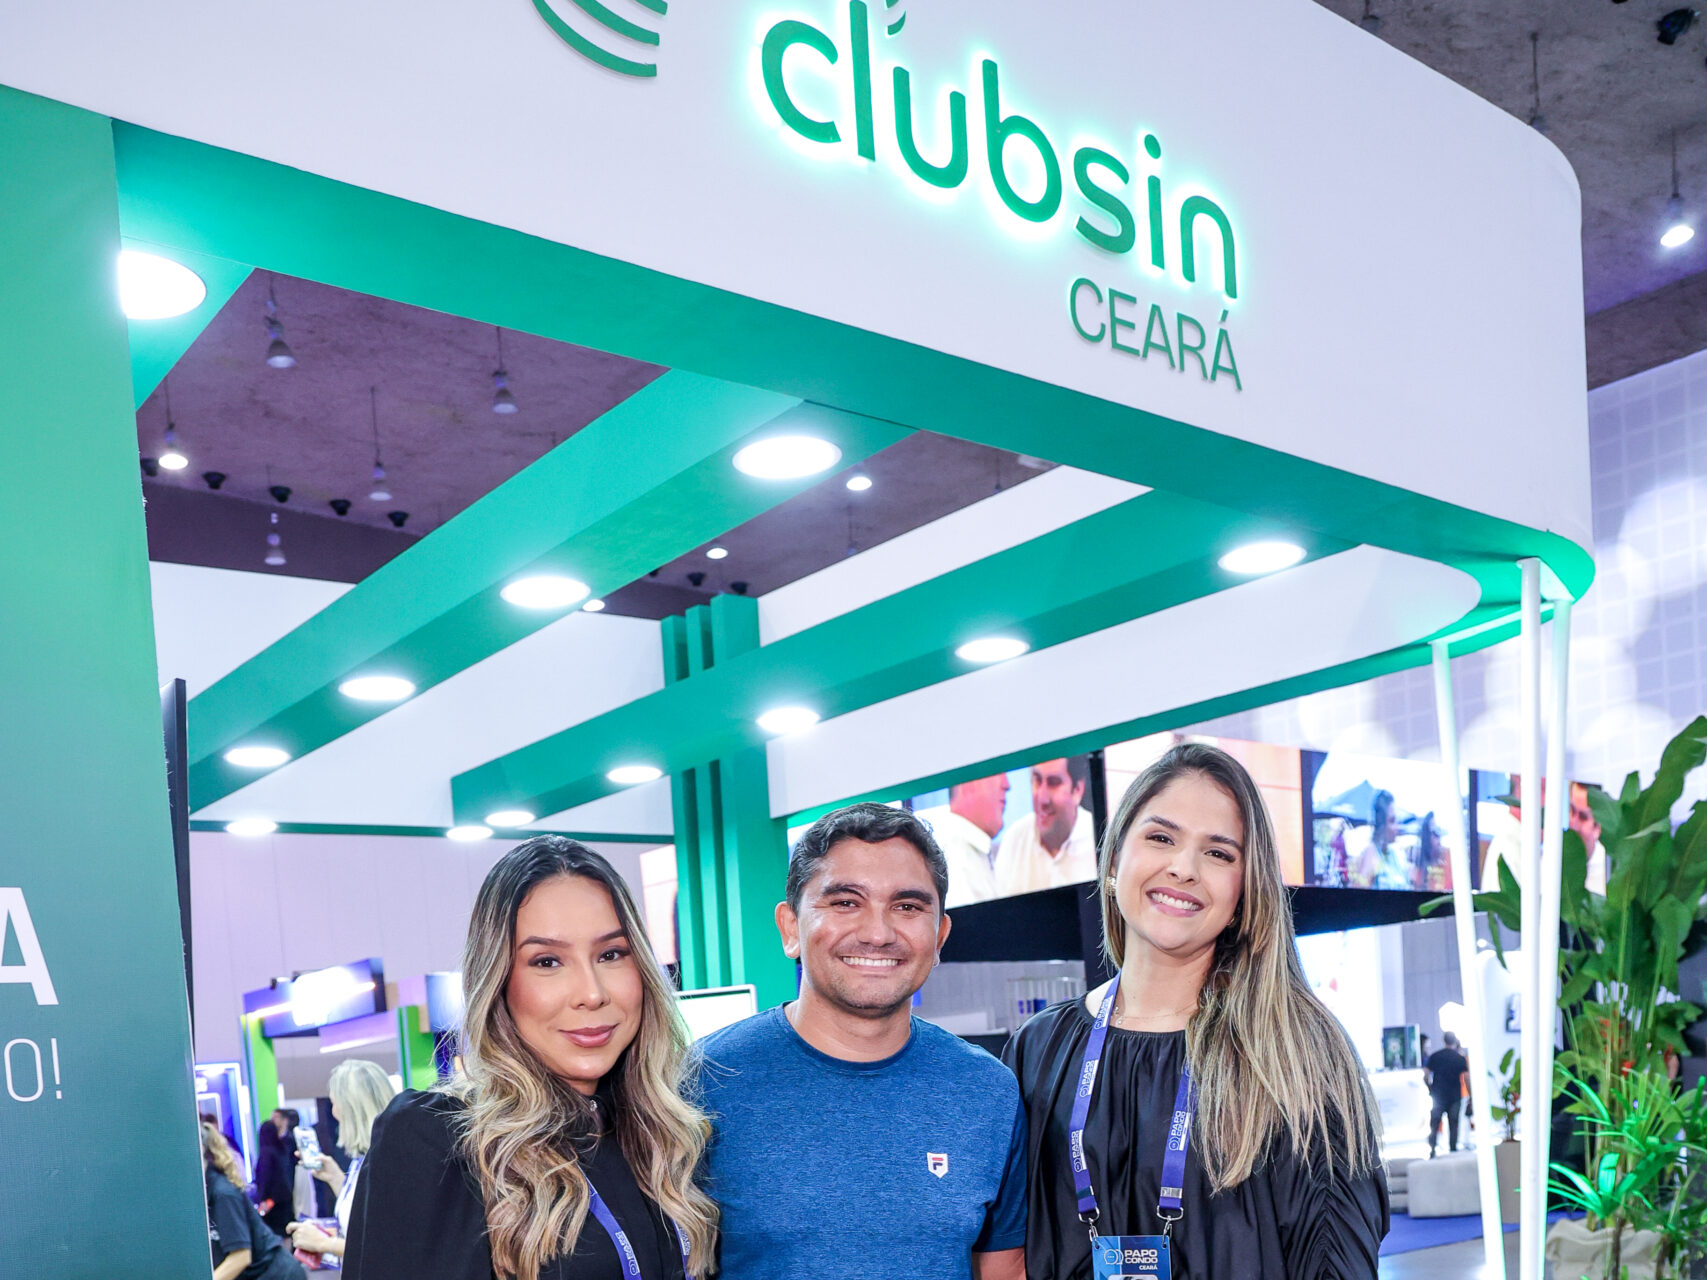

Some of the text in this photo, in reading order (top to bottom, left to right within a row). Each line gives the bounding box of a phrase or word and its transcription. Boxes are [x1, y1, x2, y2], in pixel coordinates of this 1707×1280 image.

[761, 0, 1238, 300] clubsin
[1069, 277, 1243, 391] CEARÁ
[4, 1038, 62, 1102] O!
[1171, 1110, 1182, 1136] PAPO
[1124, 1249, 1158, 1257] PAPO
